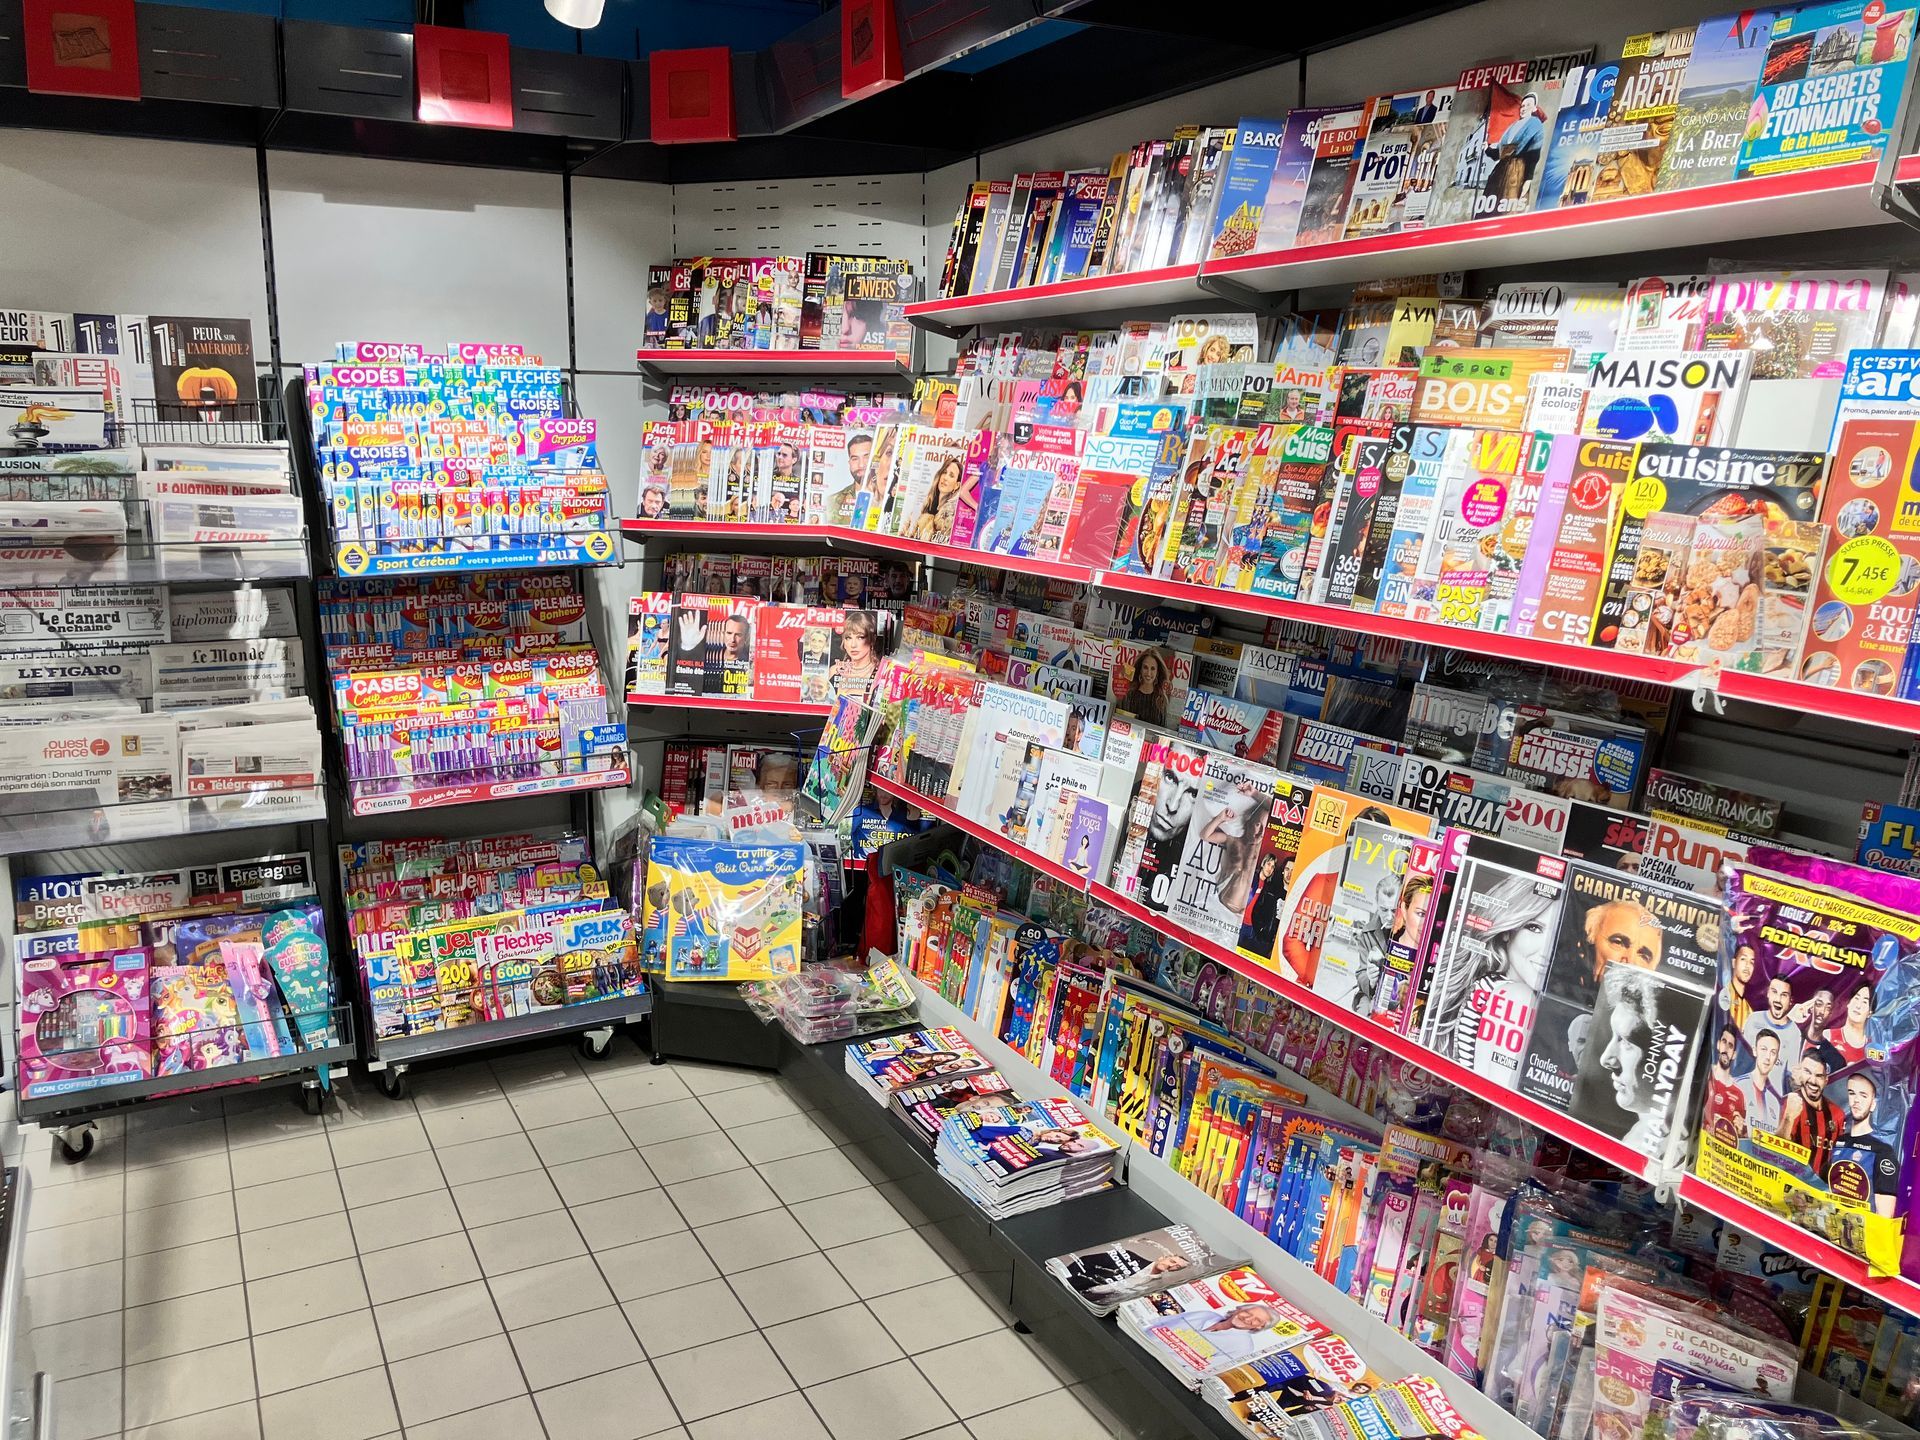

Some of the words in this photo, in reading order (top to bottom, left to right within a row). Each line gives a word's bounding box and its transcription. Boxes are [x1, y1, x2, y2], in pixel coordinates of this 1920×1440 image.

[1459, 70, 1475, 90] LE
[1774, 85, 1797, 110] 80
[1801, 67, 1883, 106] SECRETS
[1780, 134, 1792, 151] de
[1810, 129, 1848, 148] Nature
[1670, 155, 1694, 170] Une
[193, 327, 221, 341] PEUR
[1862, 356, 1898, 369] C'EST
[337, 368, 399, 384] CODÉS
[501, 370, 560, 385] FLÉCHÉS
[1591, 360, 1742, 390] MAISON
[1872, 407, 1896, 417] pannier
[347, 423, 378, 435] MOTS
[434, 422, 462, 434] MOTS
[544, 420, 594, 435] CODÉS
[644, 434, 675, 446] Paris
[350, 445, 408, 459] CROISÉS
[1638, 447, 1775, 486] cuisine
[1635, 482, 1659, 498] 120
[563, 498, 602, 508] SUDOKU
[376, 557, 409, 571] Sport
[467, 556, 490, 565] votre
[492, 554, 533, 565] partenaire
[40, 613, 59, 624] Le
[65, 611, 120, 624] Canard
[807, 609, 844, 623] Paris
[191, 650, 207, 663] Le
[210, 648, 264, 662] Monde
[549, 655, 593, 669] CASÉS
[19, 668, 43, 679] LE
[50, 666, 121, 677] FIGARO
[352, 675, 419, 694] CASÉS
[1209, 698, 1245, 723] Voile
[600, 726, 617, 734] MINI
[49, 738, 88, 749] ouest
[43, 748, 88, 759] france
[1213, 761, 1229, 772] Les
[1518, 744, 1593, 780] CHASSE
[53, 770, 82, 779] Donald
[85, 769, 112, 778] Trump
[67, 777, 100, 786] mandat
[191, 781, 204, 790] Le
[1647, 783, 1656, 798] LE
[1658, 784, 1715, 815] CHASSEUR
[1716, 802, 1774, 829] FRANÇAIS
[1505, 797, 1564, 834] 200
[1186, 842, 1227, 871] AU
[230, 863, 301, 884] Bretagne
[1641, 856, 1677, 877] SPÉCIAL
[585, 884, 606, 894] 241
[1573, 874, 1641, 904] CHARLES
[582, 934, 619, 949] passion
[564, 954, 593, 969] 210
[1668, 946, 1678, 955] SA
[1680, 948, 1695, 962] VIE
[1667, 956, 1705, 975] OEUVRE
[439, 964, 470, 984] 200
[1641, 1020, 1668, 1084] JOHNNY
[1529, 1053, 1558, 1072] Charles
[33, 1085, 55, 1094] MON
[57, 1079, 96, 1091] COFFRET
[1767, 1138, 1809, 1158] PANINI
[1665, 1327, 1684, 1342] EN
[1685, 1332, 1749, 1368] CADEAU
